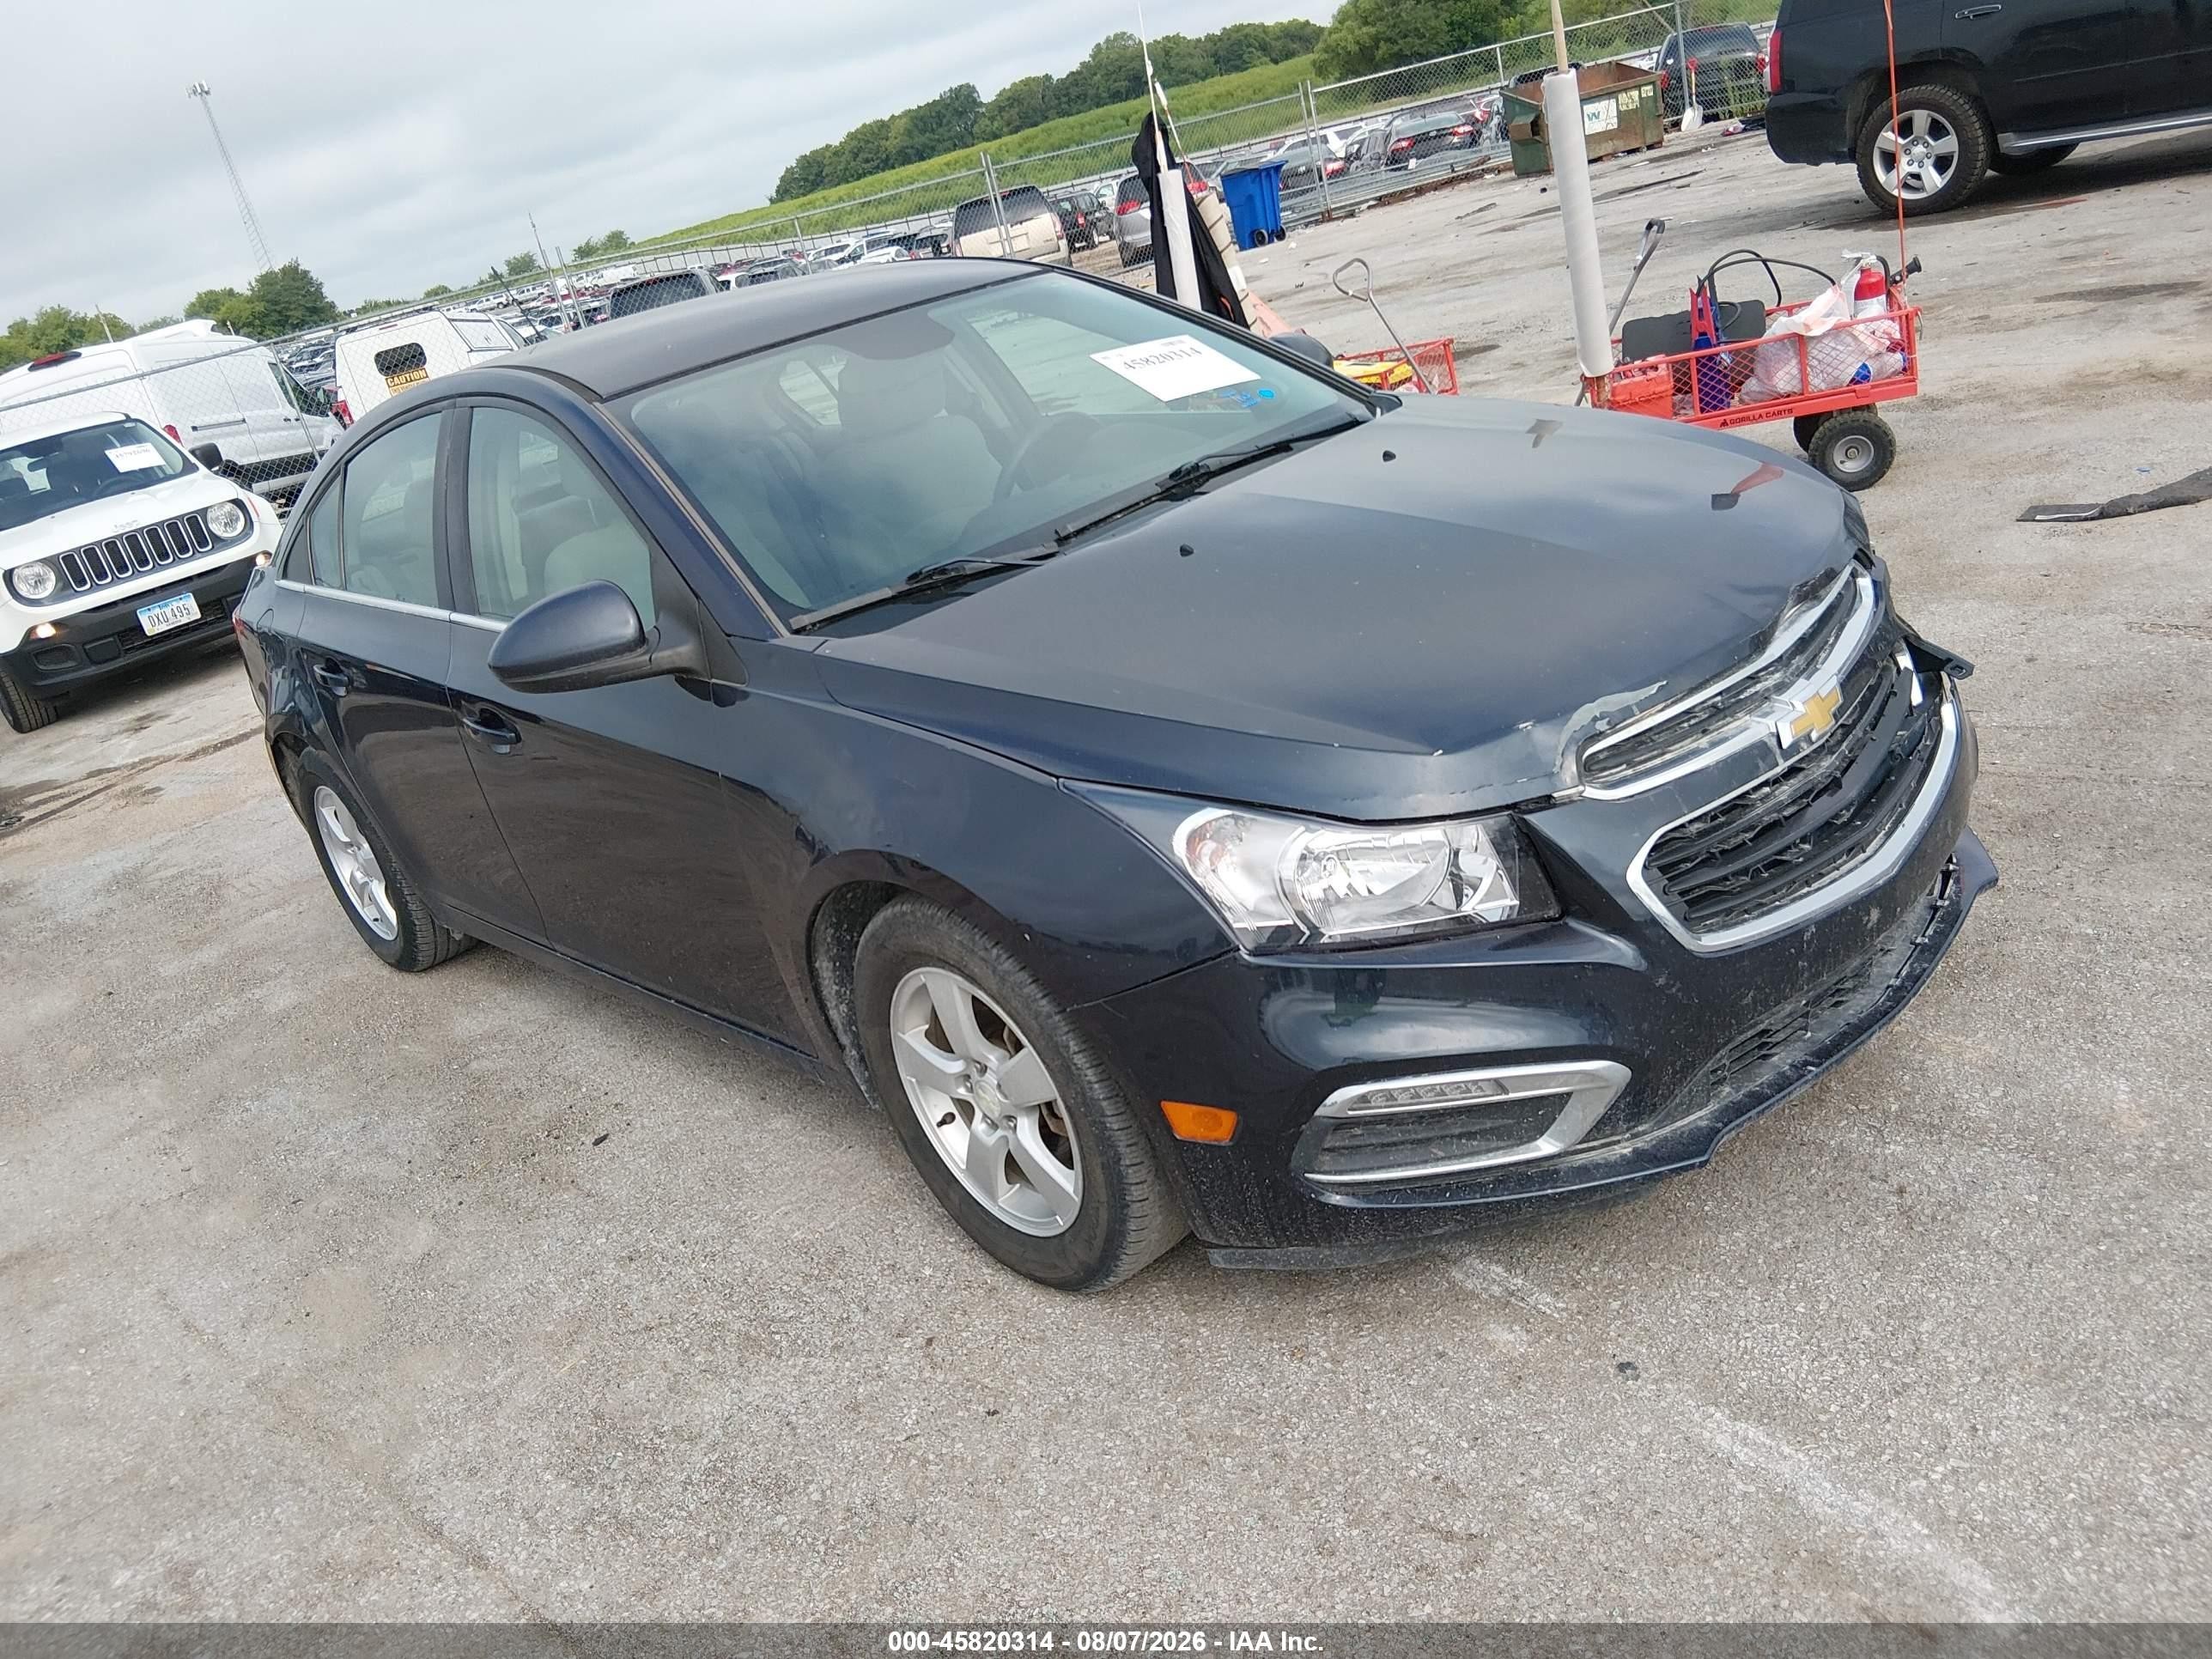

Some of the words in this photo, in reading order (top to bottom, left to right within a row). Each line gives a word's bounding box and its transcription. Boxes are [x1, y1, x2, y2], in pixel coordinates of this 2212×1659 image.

[1124, 348, 1202, 372] 45820314
[387, 369, 427, 386] CAUTION
[1729, 413, 1764, 425] GORILLA
[1765, 408, 1793, 418] CARTS
[148, 610, 169, 629] DXU
[171, 603, 191, 620] 495
